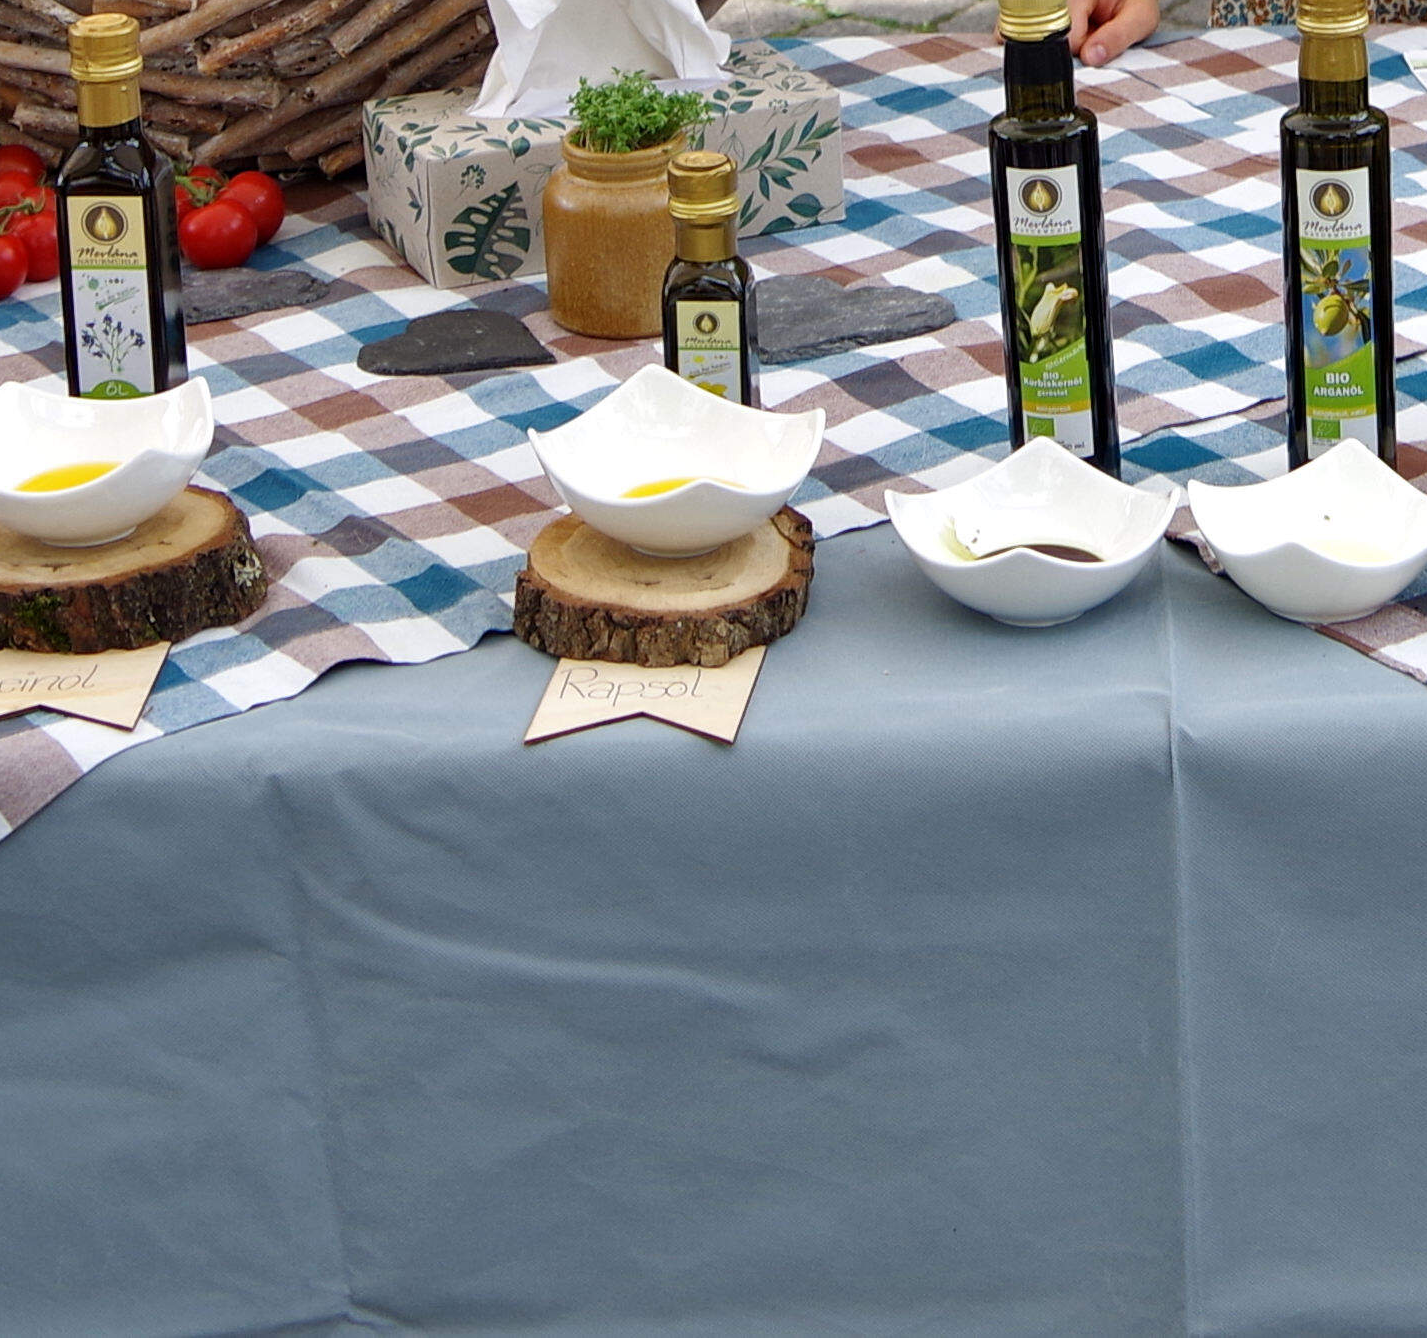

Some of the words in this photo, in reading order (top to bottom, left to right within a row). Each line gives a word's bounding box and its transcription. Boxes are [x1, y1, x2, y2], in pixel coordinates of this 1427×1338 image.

[1325, 372, 1350, 385] BIO
[104, 381, 130, 396] ÖL
[1313, 384, 1364, 397] ARGANÖL
